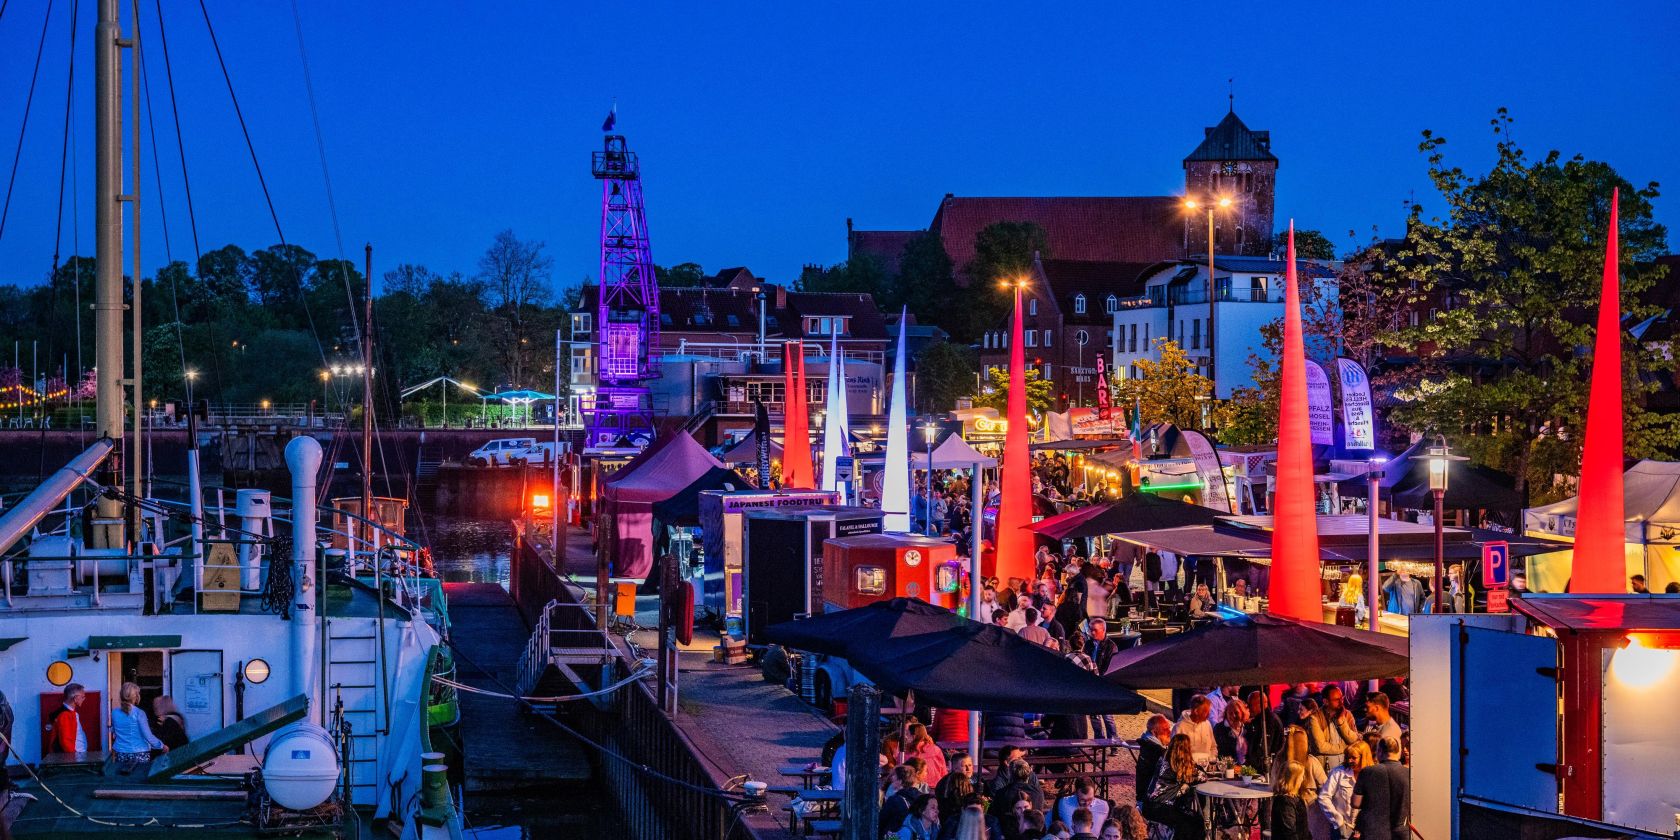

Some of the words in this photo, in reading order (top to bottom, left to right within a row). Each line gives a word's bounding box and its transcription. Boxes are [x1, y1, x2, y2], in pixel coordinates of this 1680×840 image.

[1097, 358, 1108, 404] BAR
[728, 500, 774, 508] JAPANESE
[777, 498, 835, 508] FOODTRUK
[1490, 550, 1502, 579] P
